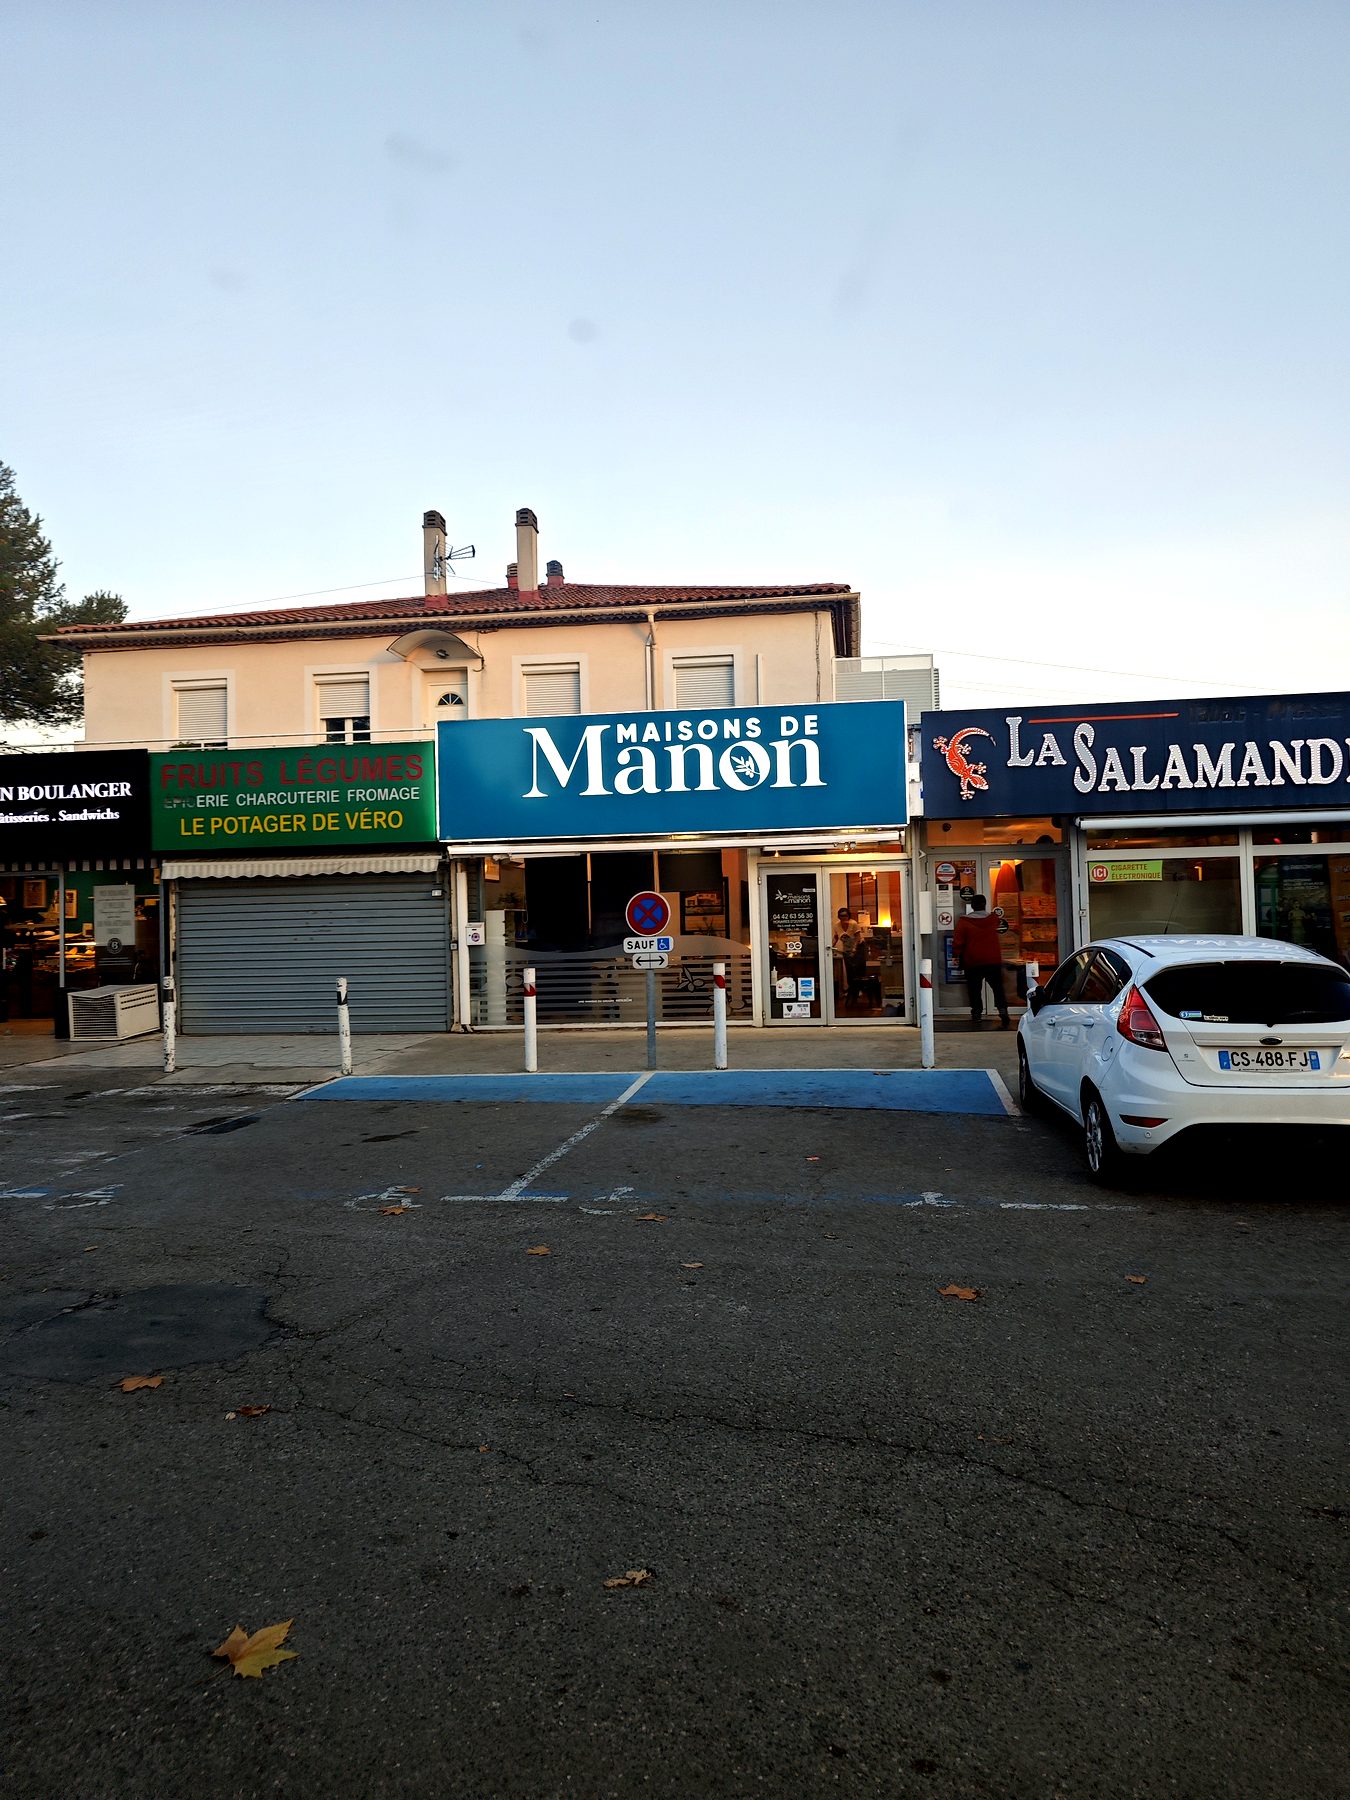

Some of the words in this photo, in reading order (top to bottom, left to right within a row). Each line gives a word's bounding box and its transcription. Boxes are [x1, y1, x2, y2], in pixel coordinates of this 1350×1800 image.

[616, 717, 763, 744] MAISONS
[780, 714, 820, 736] DE
[522, 724, 828, 799] Manon
[1005, 715, 1067, 767] LA
[1073, 722, 1350, 793] SALAMAND
[161, 761, 265, 790] FRUITS
[17, 782, 133, 801] BOULANGER
[235, 789, 341, 807] CHARCUTERIE
[346, 786, 421, 802] FROMAGE
[58, 807, 121, 822] Sandwichs
[180, 817, 206, 836] LE
[210, 814, 307, 835] POTAGER
[312, 812, 340, 831] DE
[344, 807, 404, 830] VÉRO
[626, 940, 655, 950] SAUF
